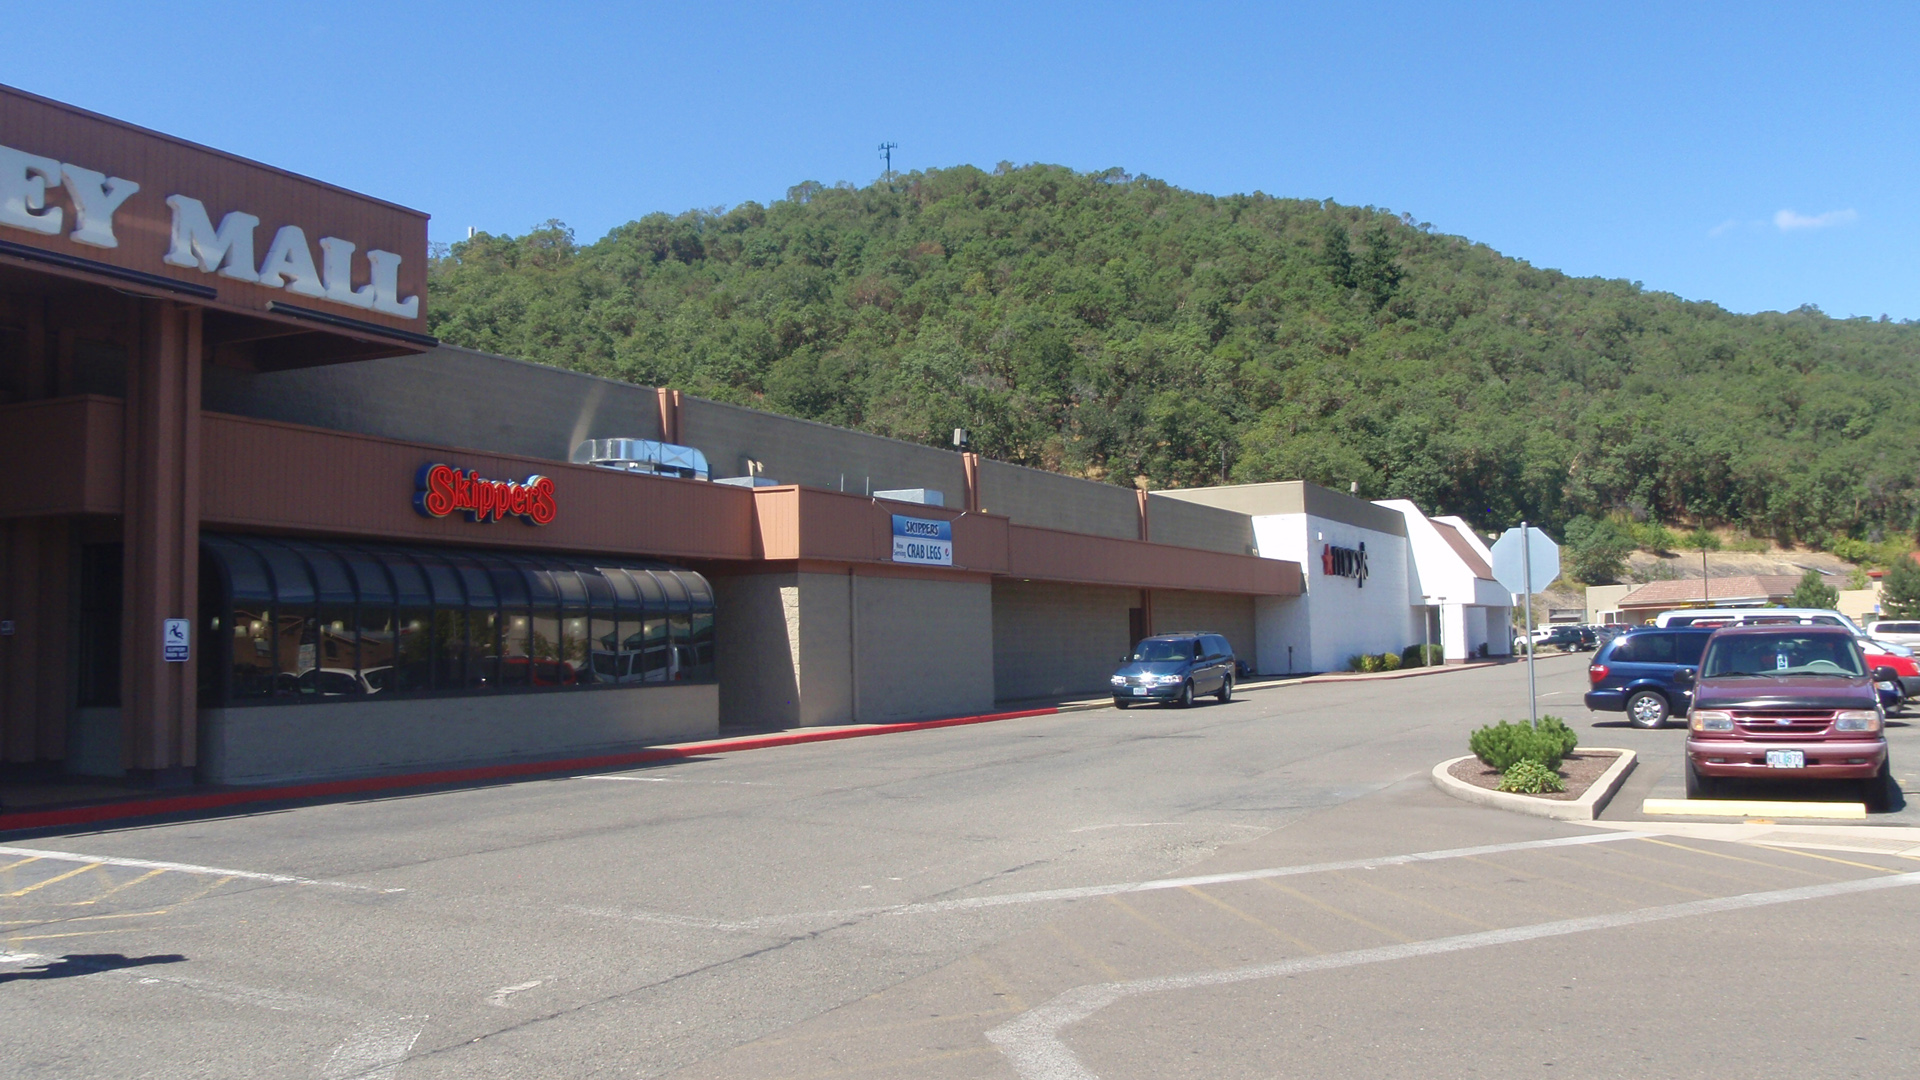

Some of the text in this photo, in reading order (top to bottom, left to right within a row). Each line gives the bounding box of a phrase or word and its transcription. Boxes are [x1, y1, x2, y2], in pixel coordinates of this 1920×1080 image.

[163, 193, 419, 320] MALL
[905, 520, 939, 536] SKIPPERS
[907, 543, 942, 560] CRAB LEGS
